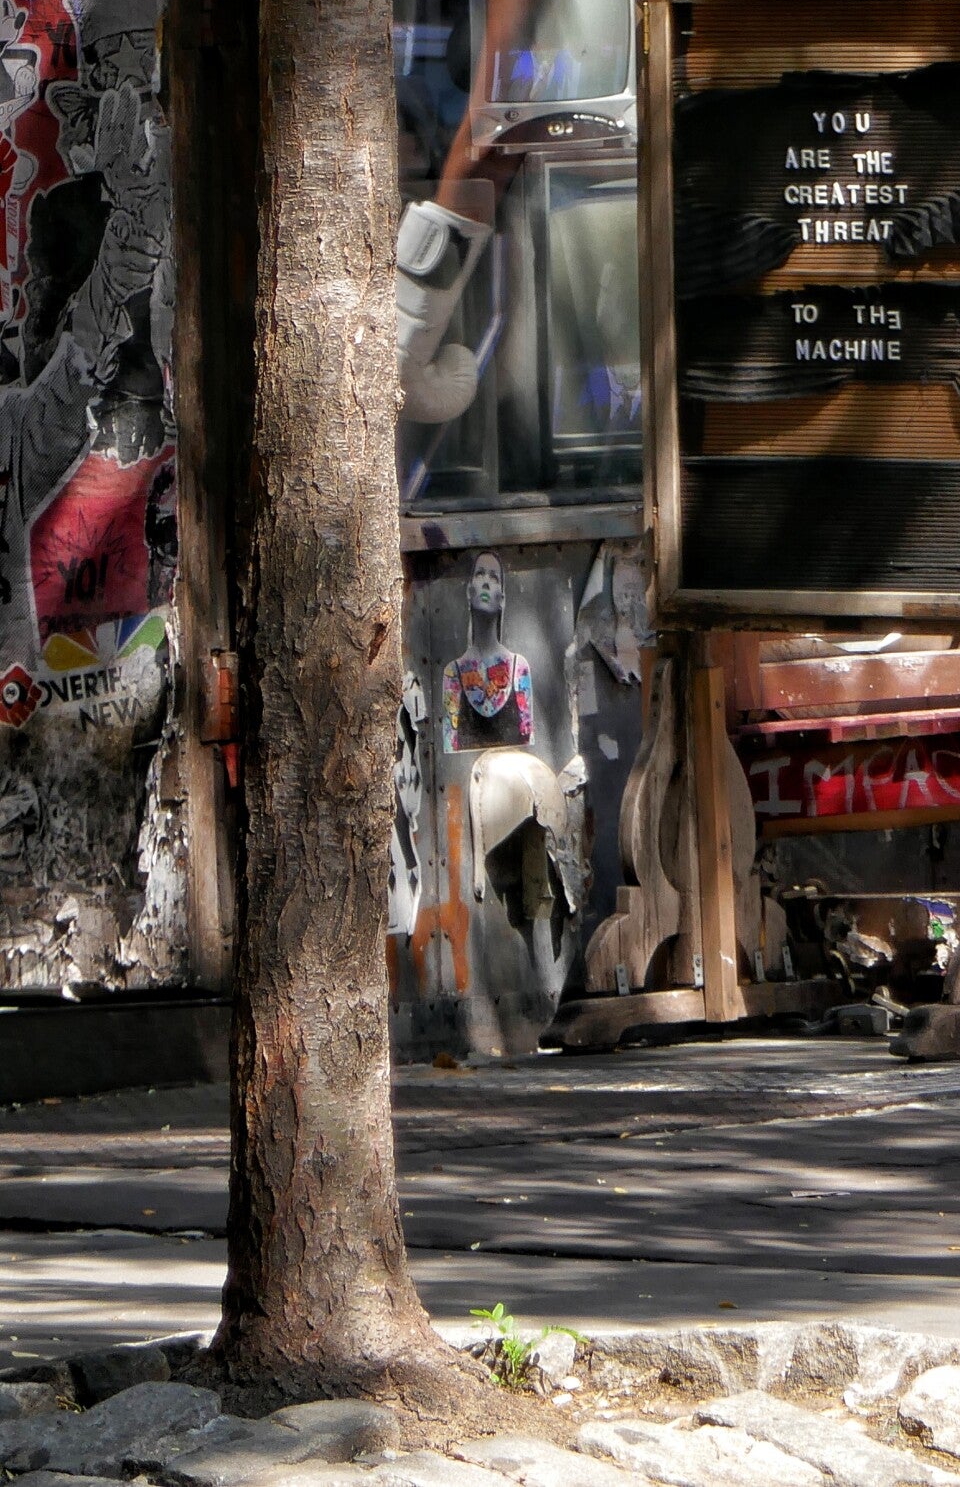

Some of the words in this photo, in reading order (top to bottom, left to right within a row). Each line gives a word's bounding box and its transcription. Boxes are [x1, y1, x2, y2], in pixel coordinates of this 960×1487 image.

[813, 112, 871, 134] YOU
[785, 147, 830, 170] ARE
[853, 151, 893, 174] THE
[797, 218, 893, 243] THREAT
[791, 303, 818, 323] TO
[796, 339, 901, 361] MACHINE
